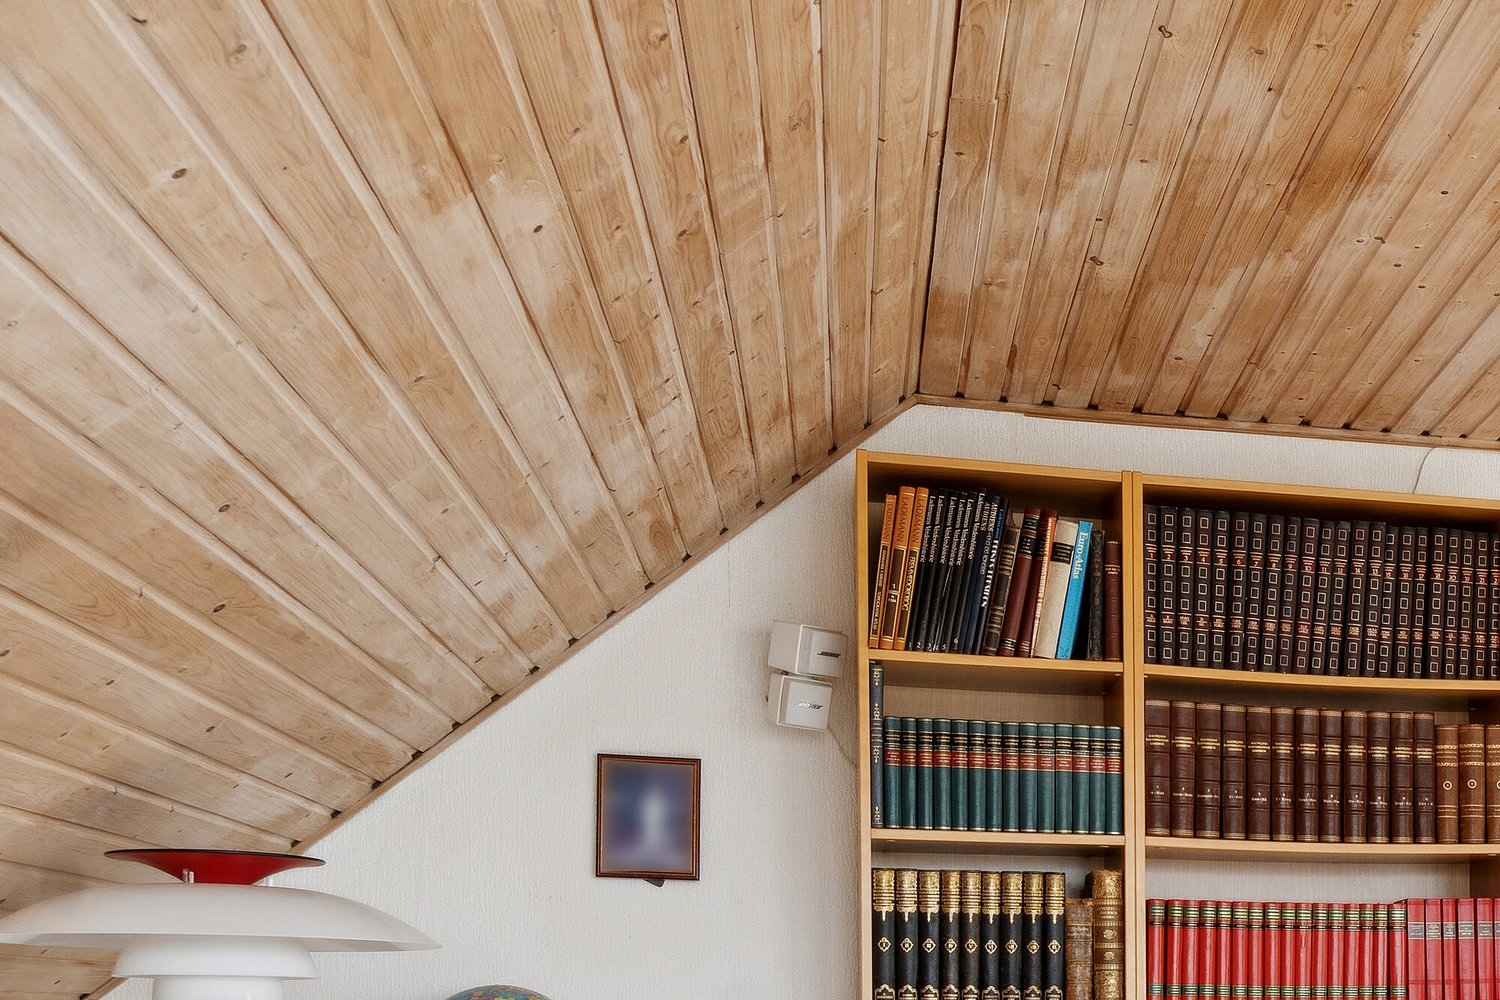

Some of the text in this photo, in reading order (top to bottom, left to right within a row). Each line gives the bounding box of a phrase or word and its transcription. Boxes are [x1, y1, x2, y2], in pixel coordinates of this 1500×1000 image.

[897, 497, 910, 542] LADEMANN
[912, 498, 924, 543] LADEMANN
[925, 496, 935, 525] Lademanns
[935, 495, 944, 525] Lademanns
[946, 497, 956, 526] Lademanns
[955, 499, 965, 529] Lademanns
[963, 499, 973, 529] Lademanns
[974, 493, 984, 521] Lademanns
[981, 502, 990, 531] AUDIENS
[988, 503, 997, 531] AUDIENS
[902, 556, 915, 611] FREMMEDORDBOG
